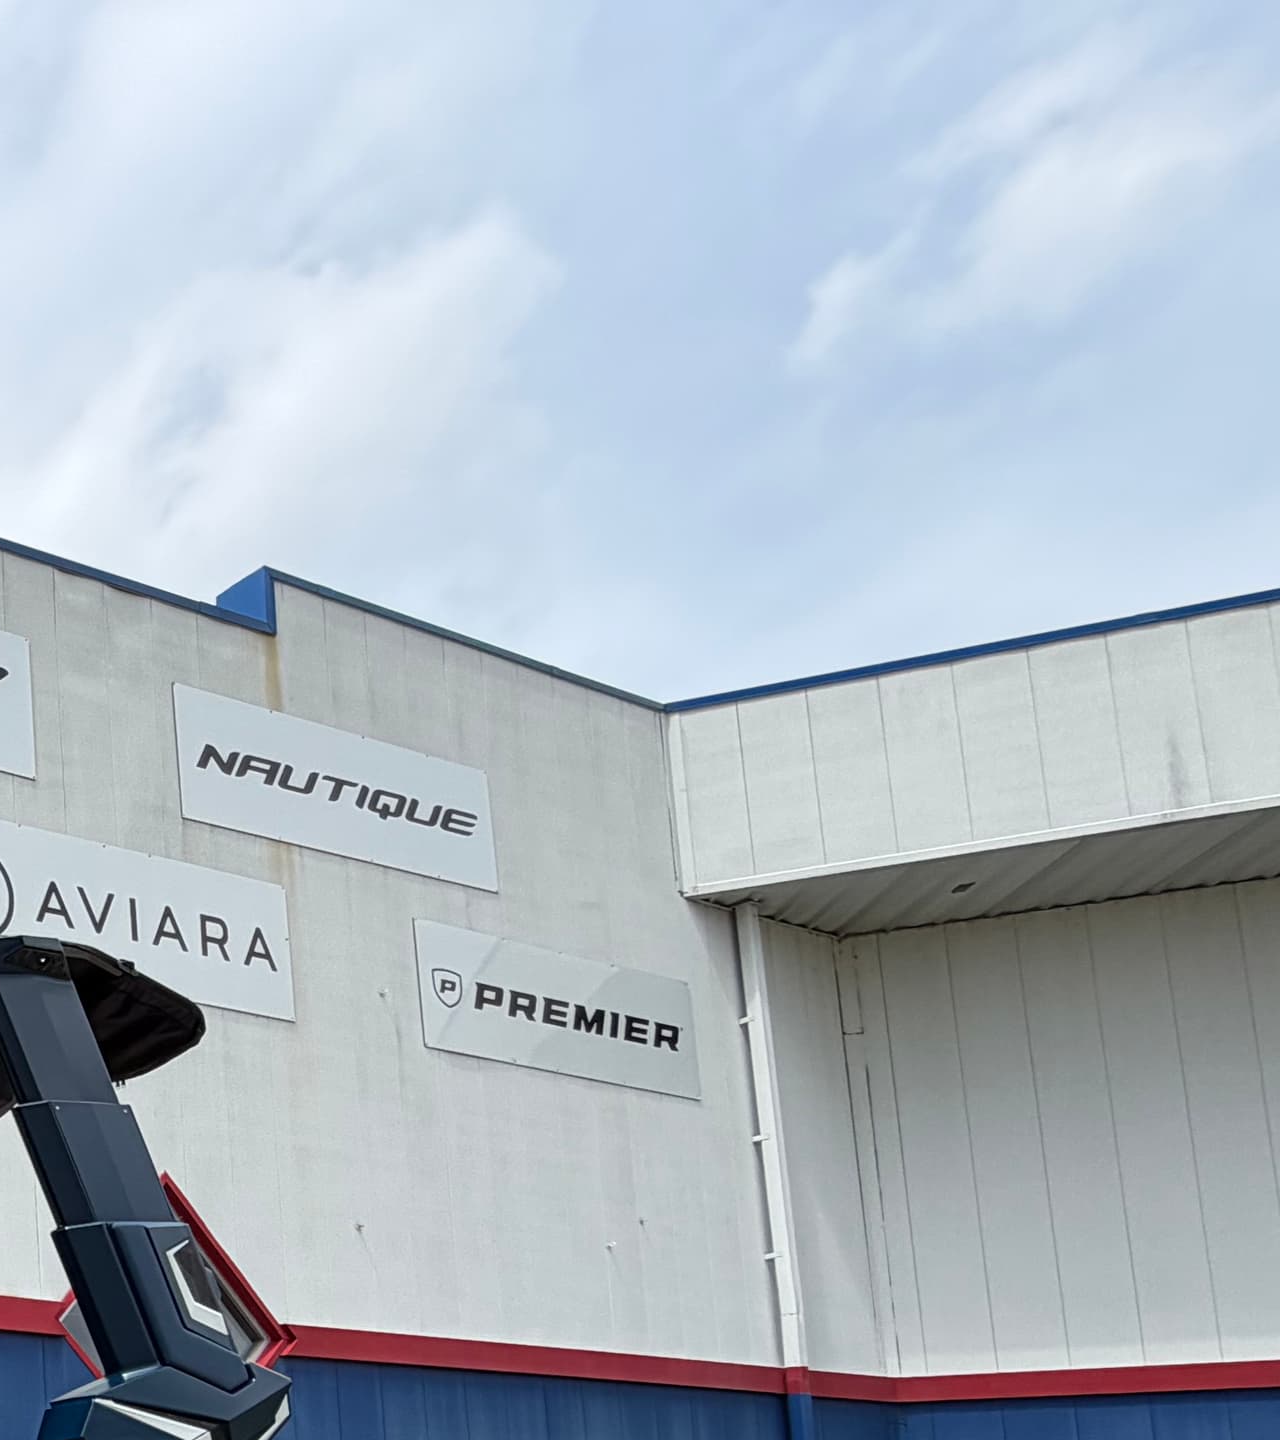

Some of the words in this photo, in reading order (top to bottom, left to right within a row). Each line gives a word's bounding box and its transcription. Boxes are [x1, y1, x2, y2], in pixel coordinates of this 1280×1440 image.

[196, 743, 478, 837] NAUTIQUE
[36, 881, 278, 972] AVIARA
[440, 978, 456, 994] P
[474, 982, 679, 1051] PREMIER
